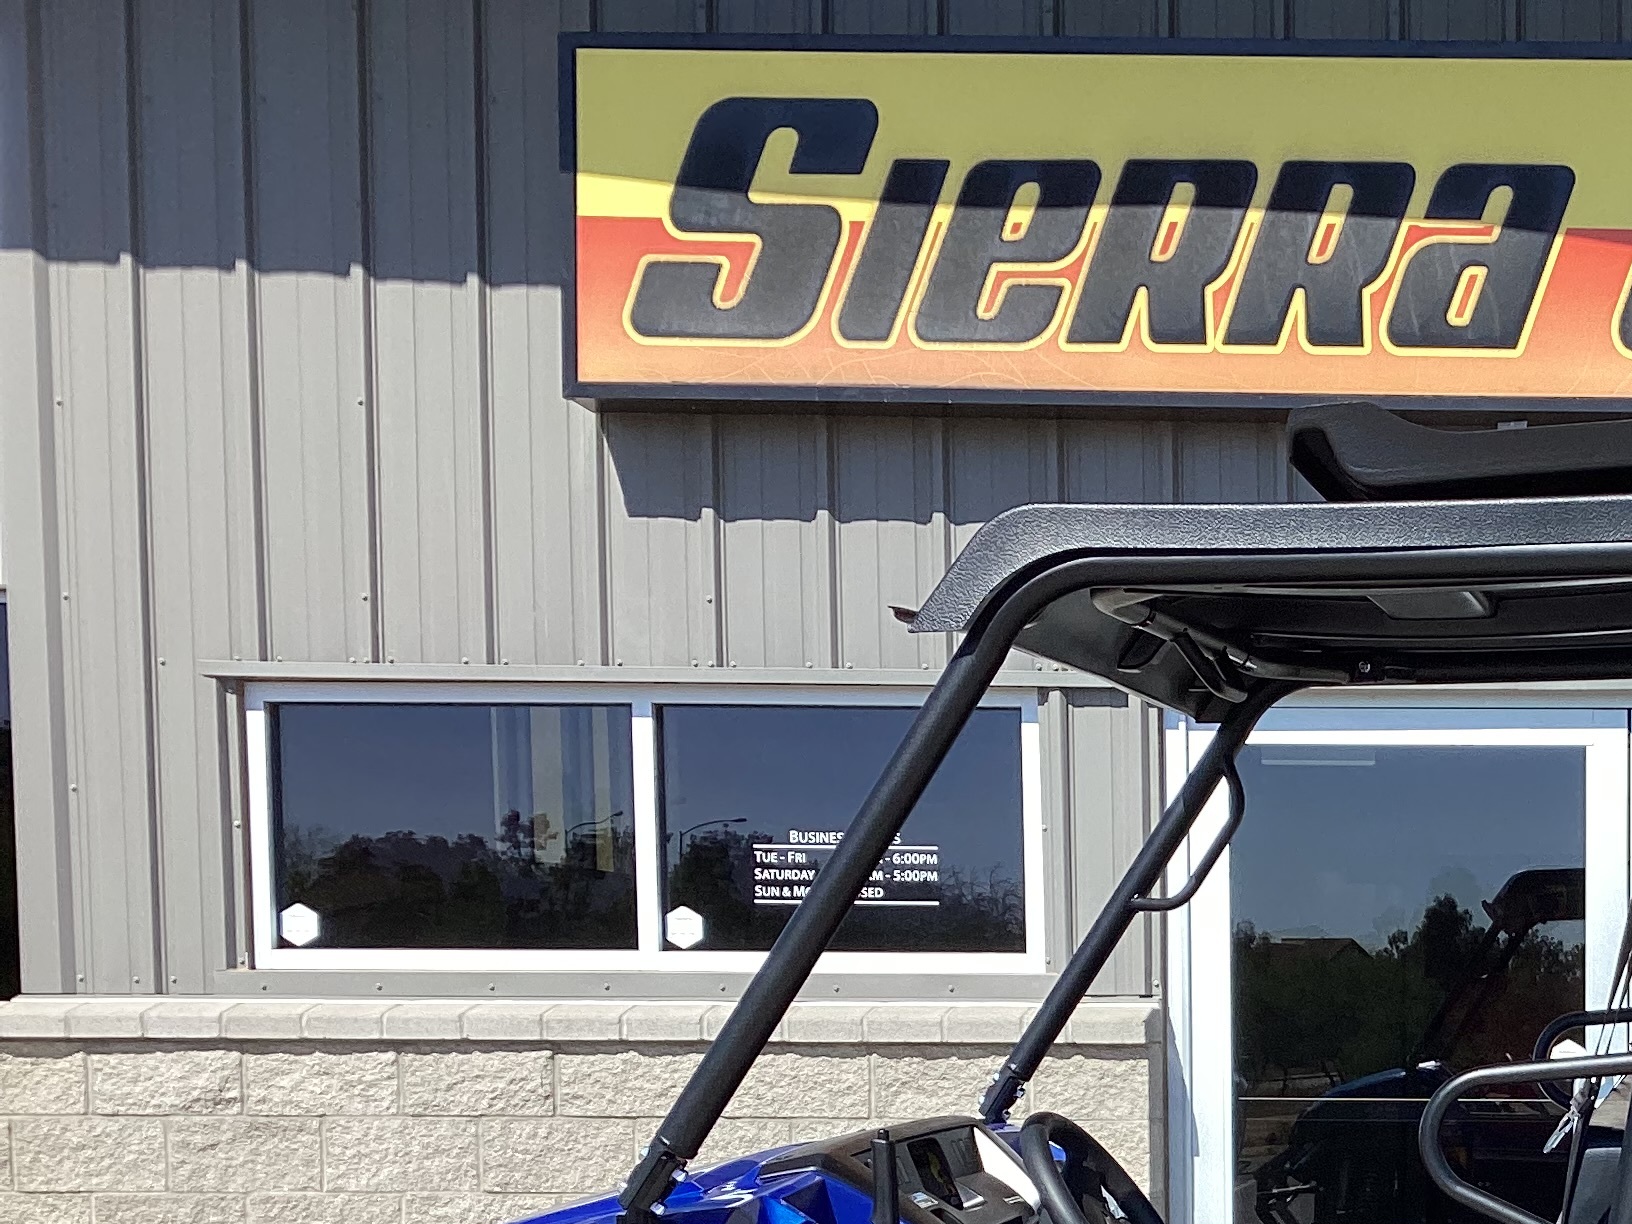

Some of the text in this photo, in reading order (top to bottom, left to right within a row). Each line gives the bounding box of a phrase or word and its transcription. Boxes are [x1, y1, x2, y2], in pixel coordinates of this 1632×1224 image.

[624, 95, 1576, 358] Sierra
[788, 829, 845, 844] BUSINES
[754, 851, 778, 863] TUE
[787, 851, 806, 863] FRI
[892, 852, 938, 865] 6:00PM
[754, 868, 816, 880] SATURDAY
[892, 869, 939, 882] 5:00PM
[754, 885, 780, 897] SUN
[781, 886, 792, 897] &
